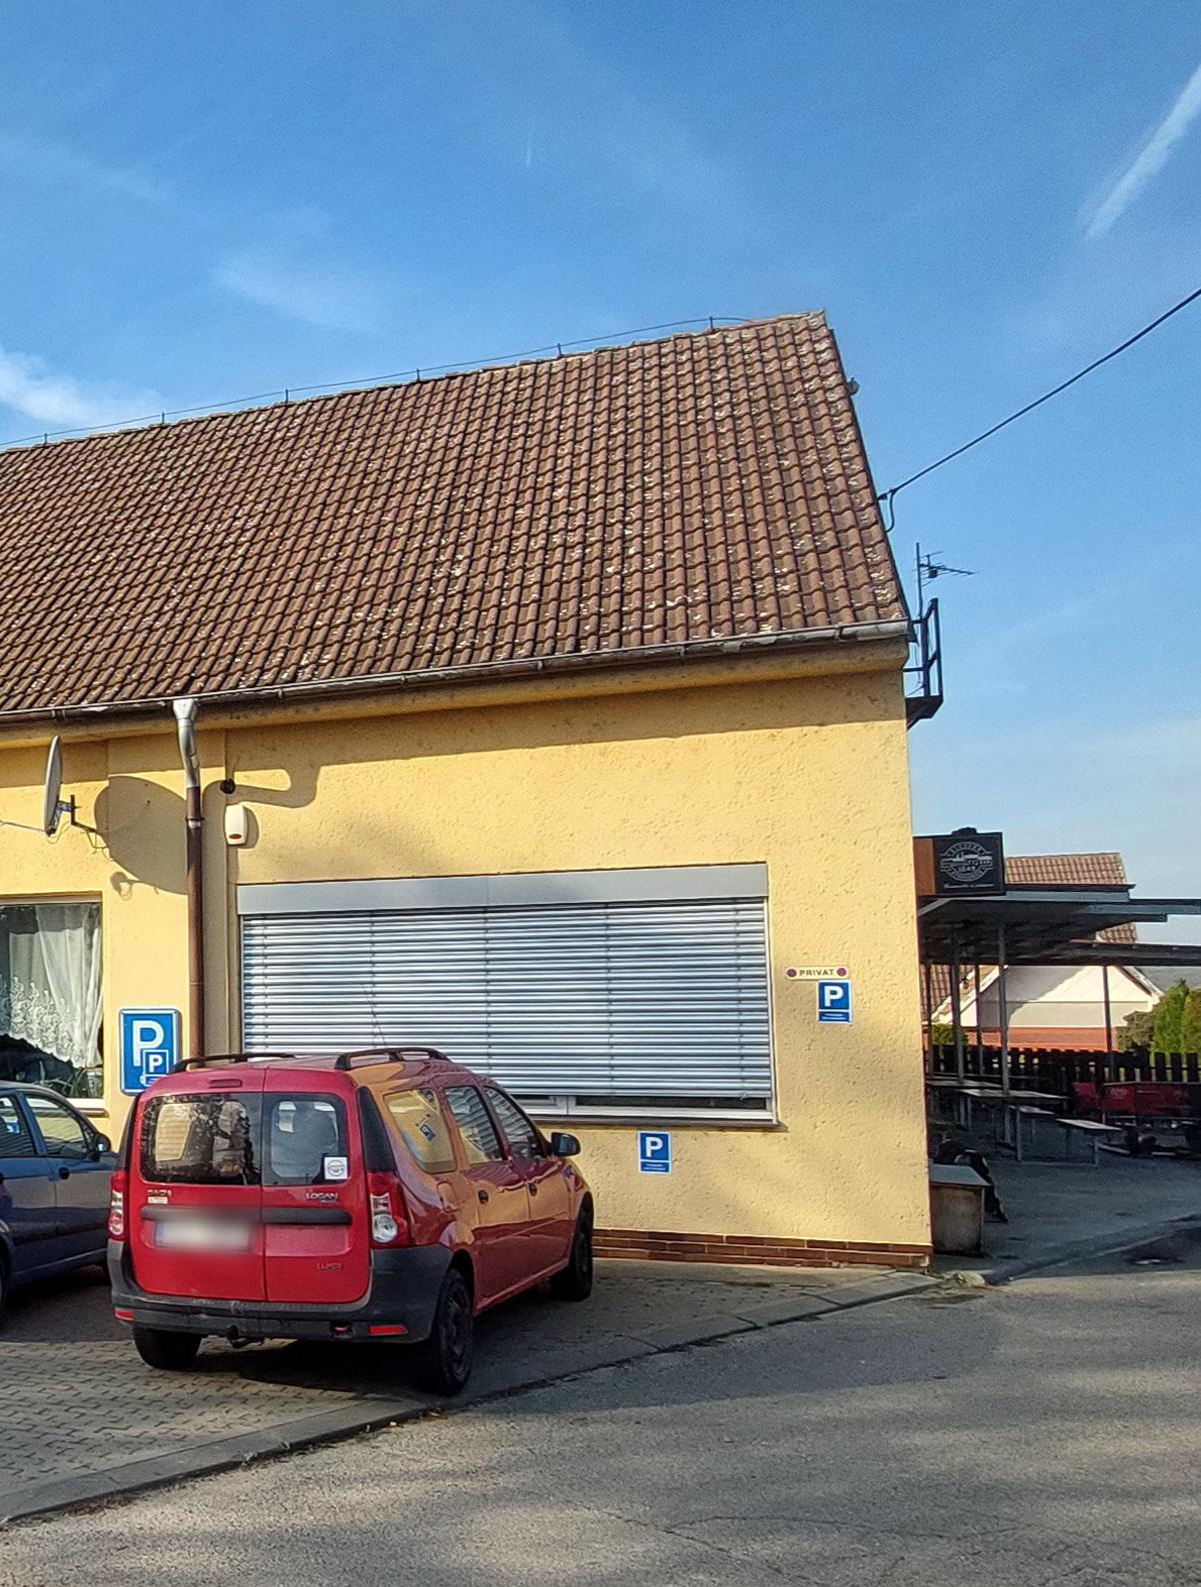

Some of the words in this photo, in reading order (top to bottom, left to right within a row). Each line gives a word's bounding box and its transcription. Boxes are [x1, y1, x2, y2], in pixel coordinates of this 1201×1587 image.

[823, 985, 843, 1007] P
[132, 1020, 164, 1067] P
[149, 1054, 163, 1073] P
[645, 1136, 663, 1158] P
[305, 1192, 339, 1200] LOGAN
